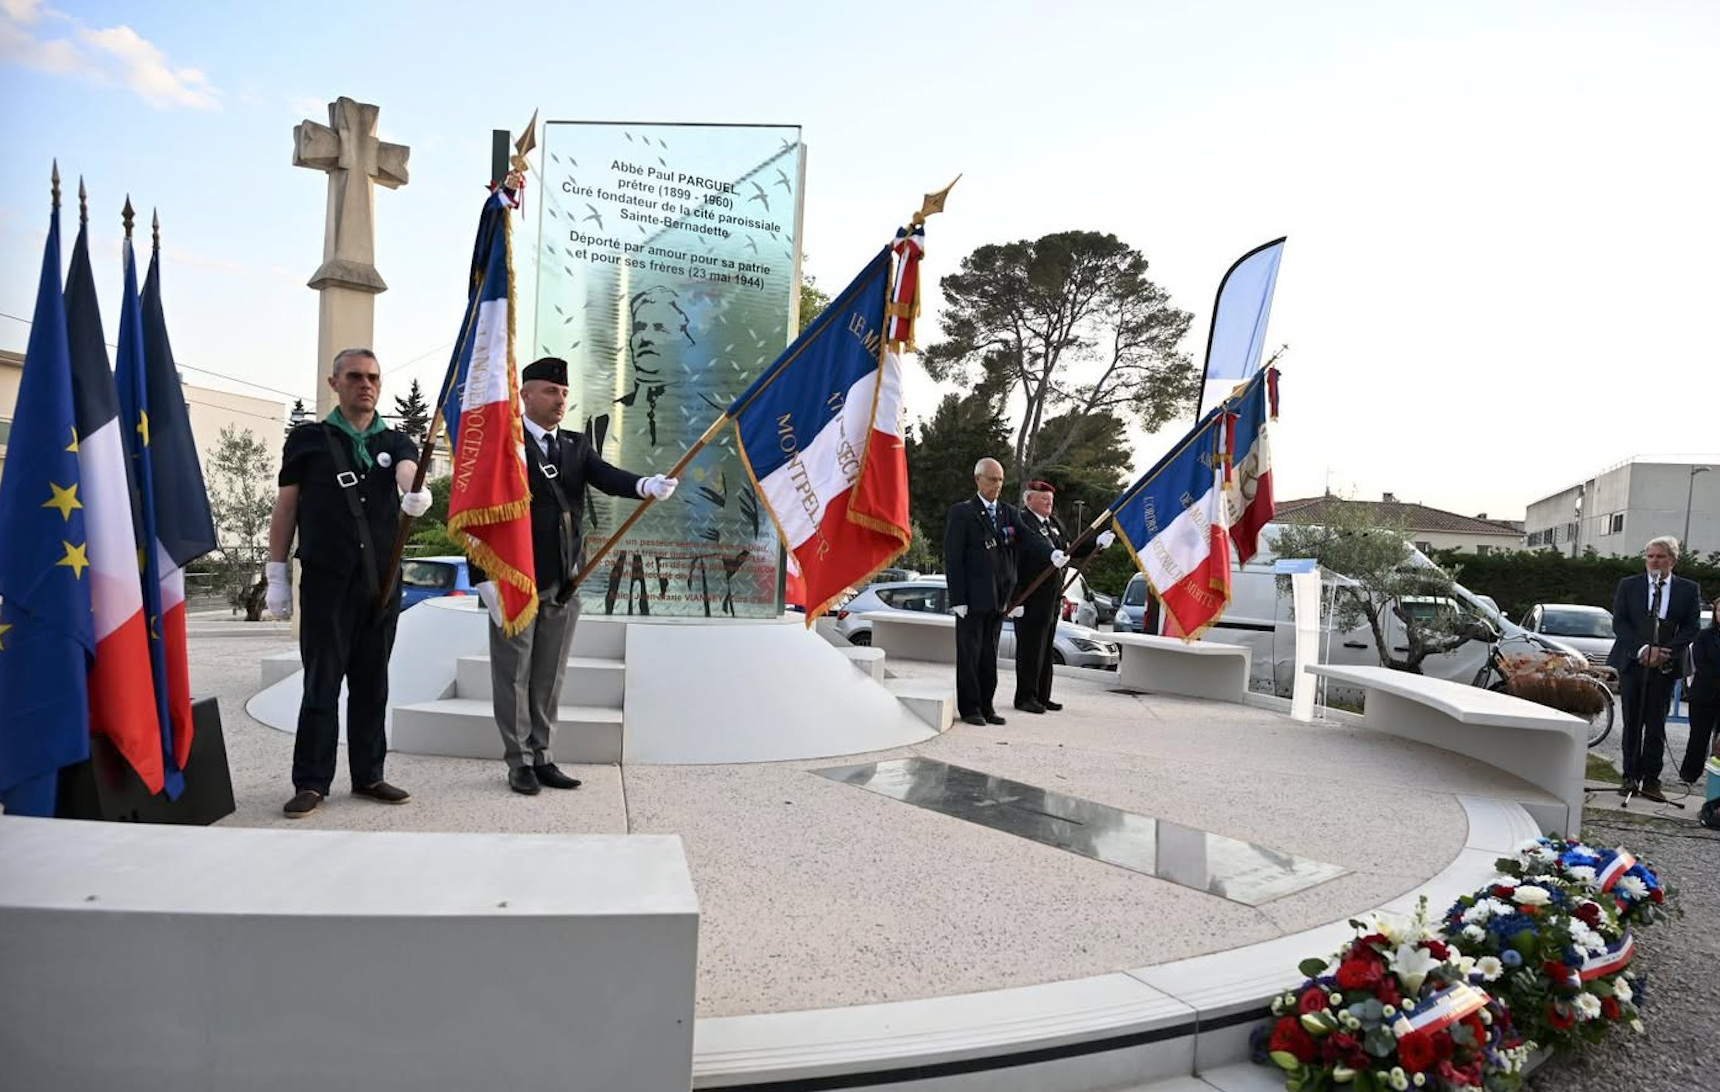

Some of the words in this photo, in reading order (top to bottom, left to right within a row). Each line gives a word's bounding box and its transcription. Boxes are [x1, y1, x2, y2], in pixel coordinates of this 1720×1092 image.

[611, 160, 644, 176] Abbé
[647, 167, 674, 182] Paul
[561, 181, 593, 198] Curé
[597, 188, 658, 210] fondateur
[661, 202, 676, 213] de
[680, 204, 690, 217] la
[693, 209, 715, 221] cité
[718, 213, 781, 233] paroissiale
[618, 179, 655, 194] prêtre
[658, 185, 691, 201] (1899
[703, 194, 733, 211] 1960)
[620, 208, 730, 238] Sainte-Bernadette
[569, 230, 621, 250] Déporté
[624, 242, 645, 254] par
[648, 246, 688, 261] amour
[690, 253, 718, 265] pour
[721, 260, 735, 269] sa
[738, 262, 771, 275] patrie
[575, 249, 587, 260] et
[591, 252, 621, 264] pour
[624, 258, 646, 269] ses
[650, 260, 685, 276] frères
[688, 266, 707, 280] (23
[710, 272, 731, 283] mai
[735, 274, 765, 291] 1944)
